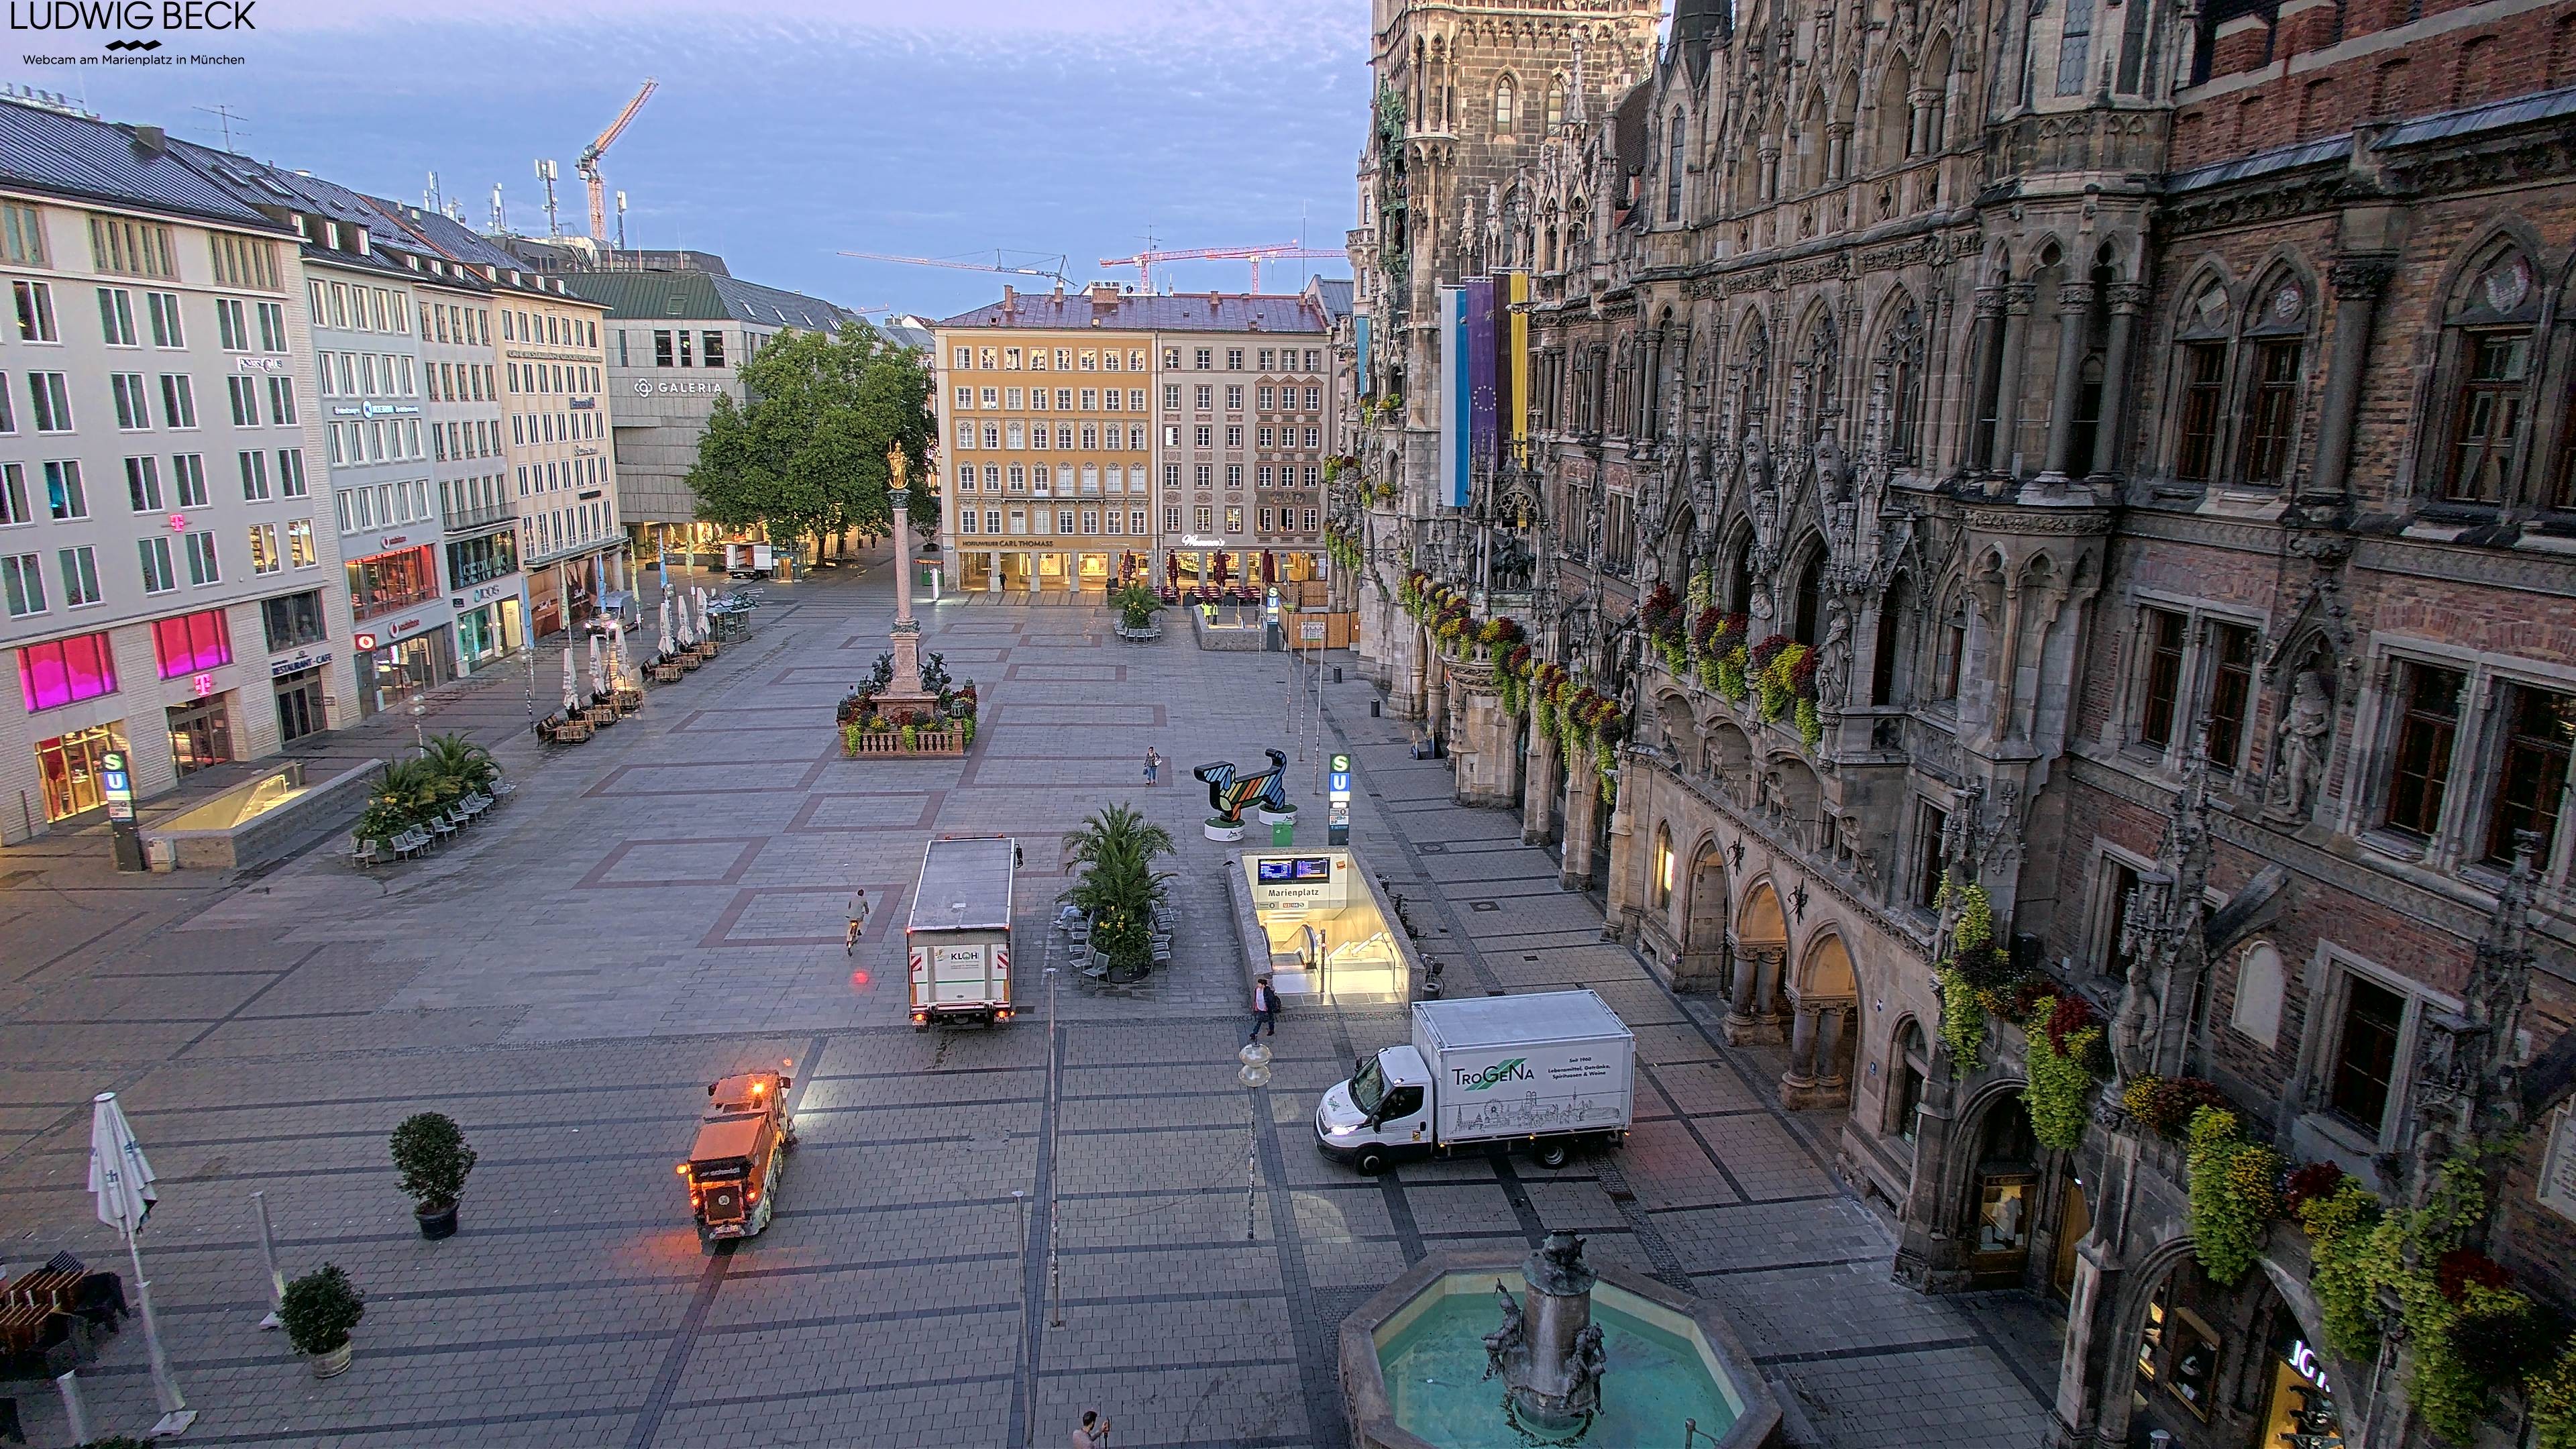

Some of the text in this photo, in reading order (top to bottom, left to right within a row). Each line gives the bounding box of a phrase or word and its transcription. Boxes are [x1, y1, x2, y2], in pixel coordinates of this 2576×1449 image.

[658, 382, 722, 393] GALERIA
[1269, 587, 1277, 596] S
[1269, 598, 1277, 606] U
[104, 754, 121, 770] S
[1334, 755, 1348, 771] S
[107, 773, 123, 789] U
[1333, 775, 1346, 790] U
[1268, 888, 1320, 898] Marienplatz
